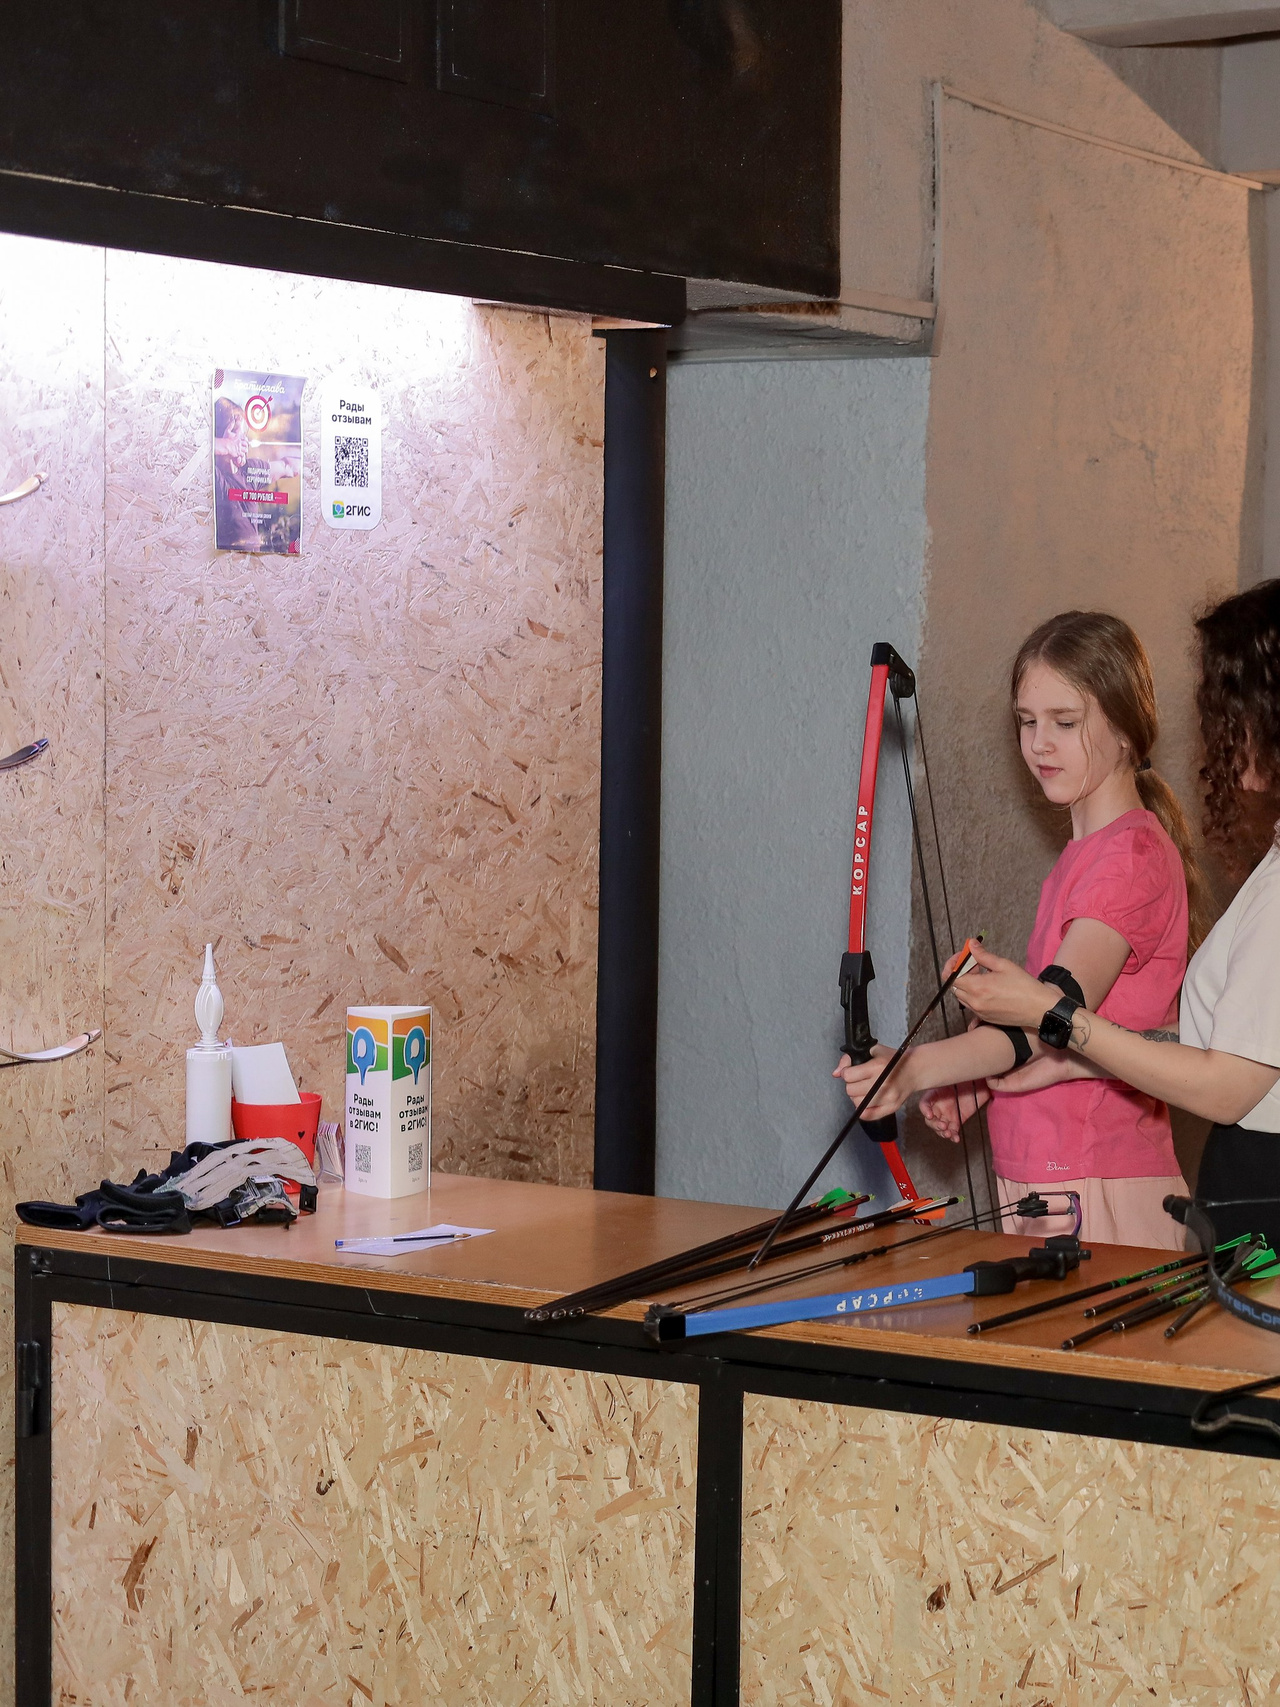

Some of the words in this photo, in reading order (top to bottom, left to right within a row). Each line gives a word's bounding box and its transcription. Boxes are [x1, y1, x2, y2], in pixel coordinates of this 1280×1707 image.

[340, 400, 365, 413] Рады
[331, 414, 372, 425] отзывам
[345, 505, 371, 517] 2ГИС
[852, 805, 869, 895] КОРСАР
[354, 1093, 374, 1107] Рады
[406, 1094, 425, 1106] Рады
[349, 1106, 381, 1119] отзывам
[399, 1105, 428, 1118] отзывам
[350, 1120, 354, 1128] в
[354, 1119, 379, 1132] 2ГИС!
[401, 1124, 406, 1132] в
[407, 1117, 427, 1131] 2ГИС!
